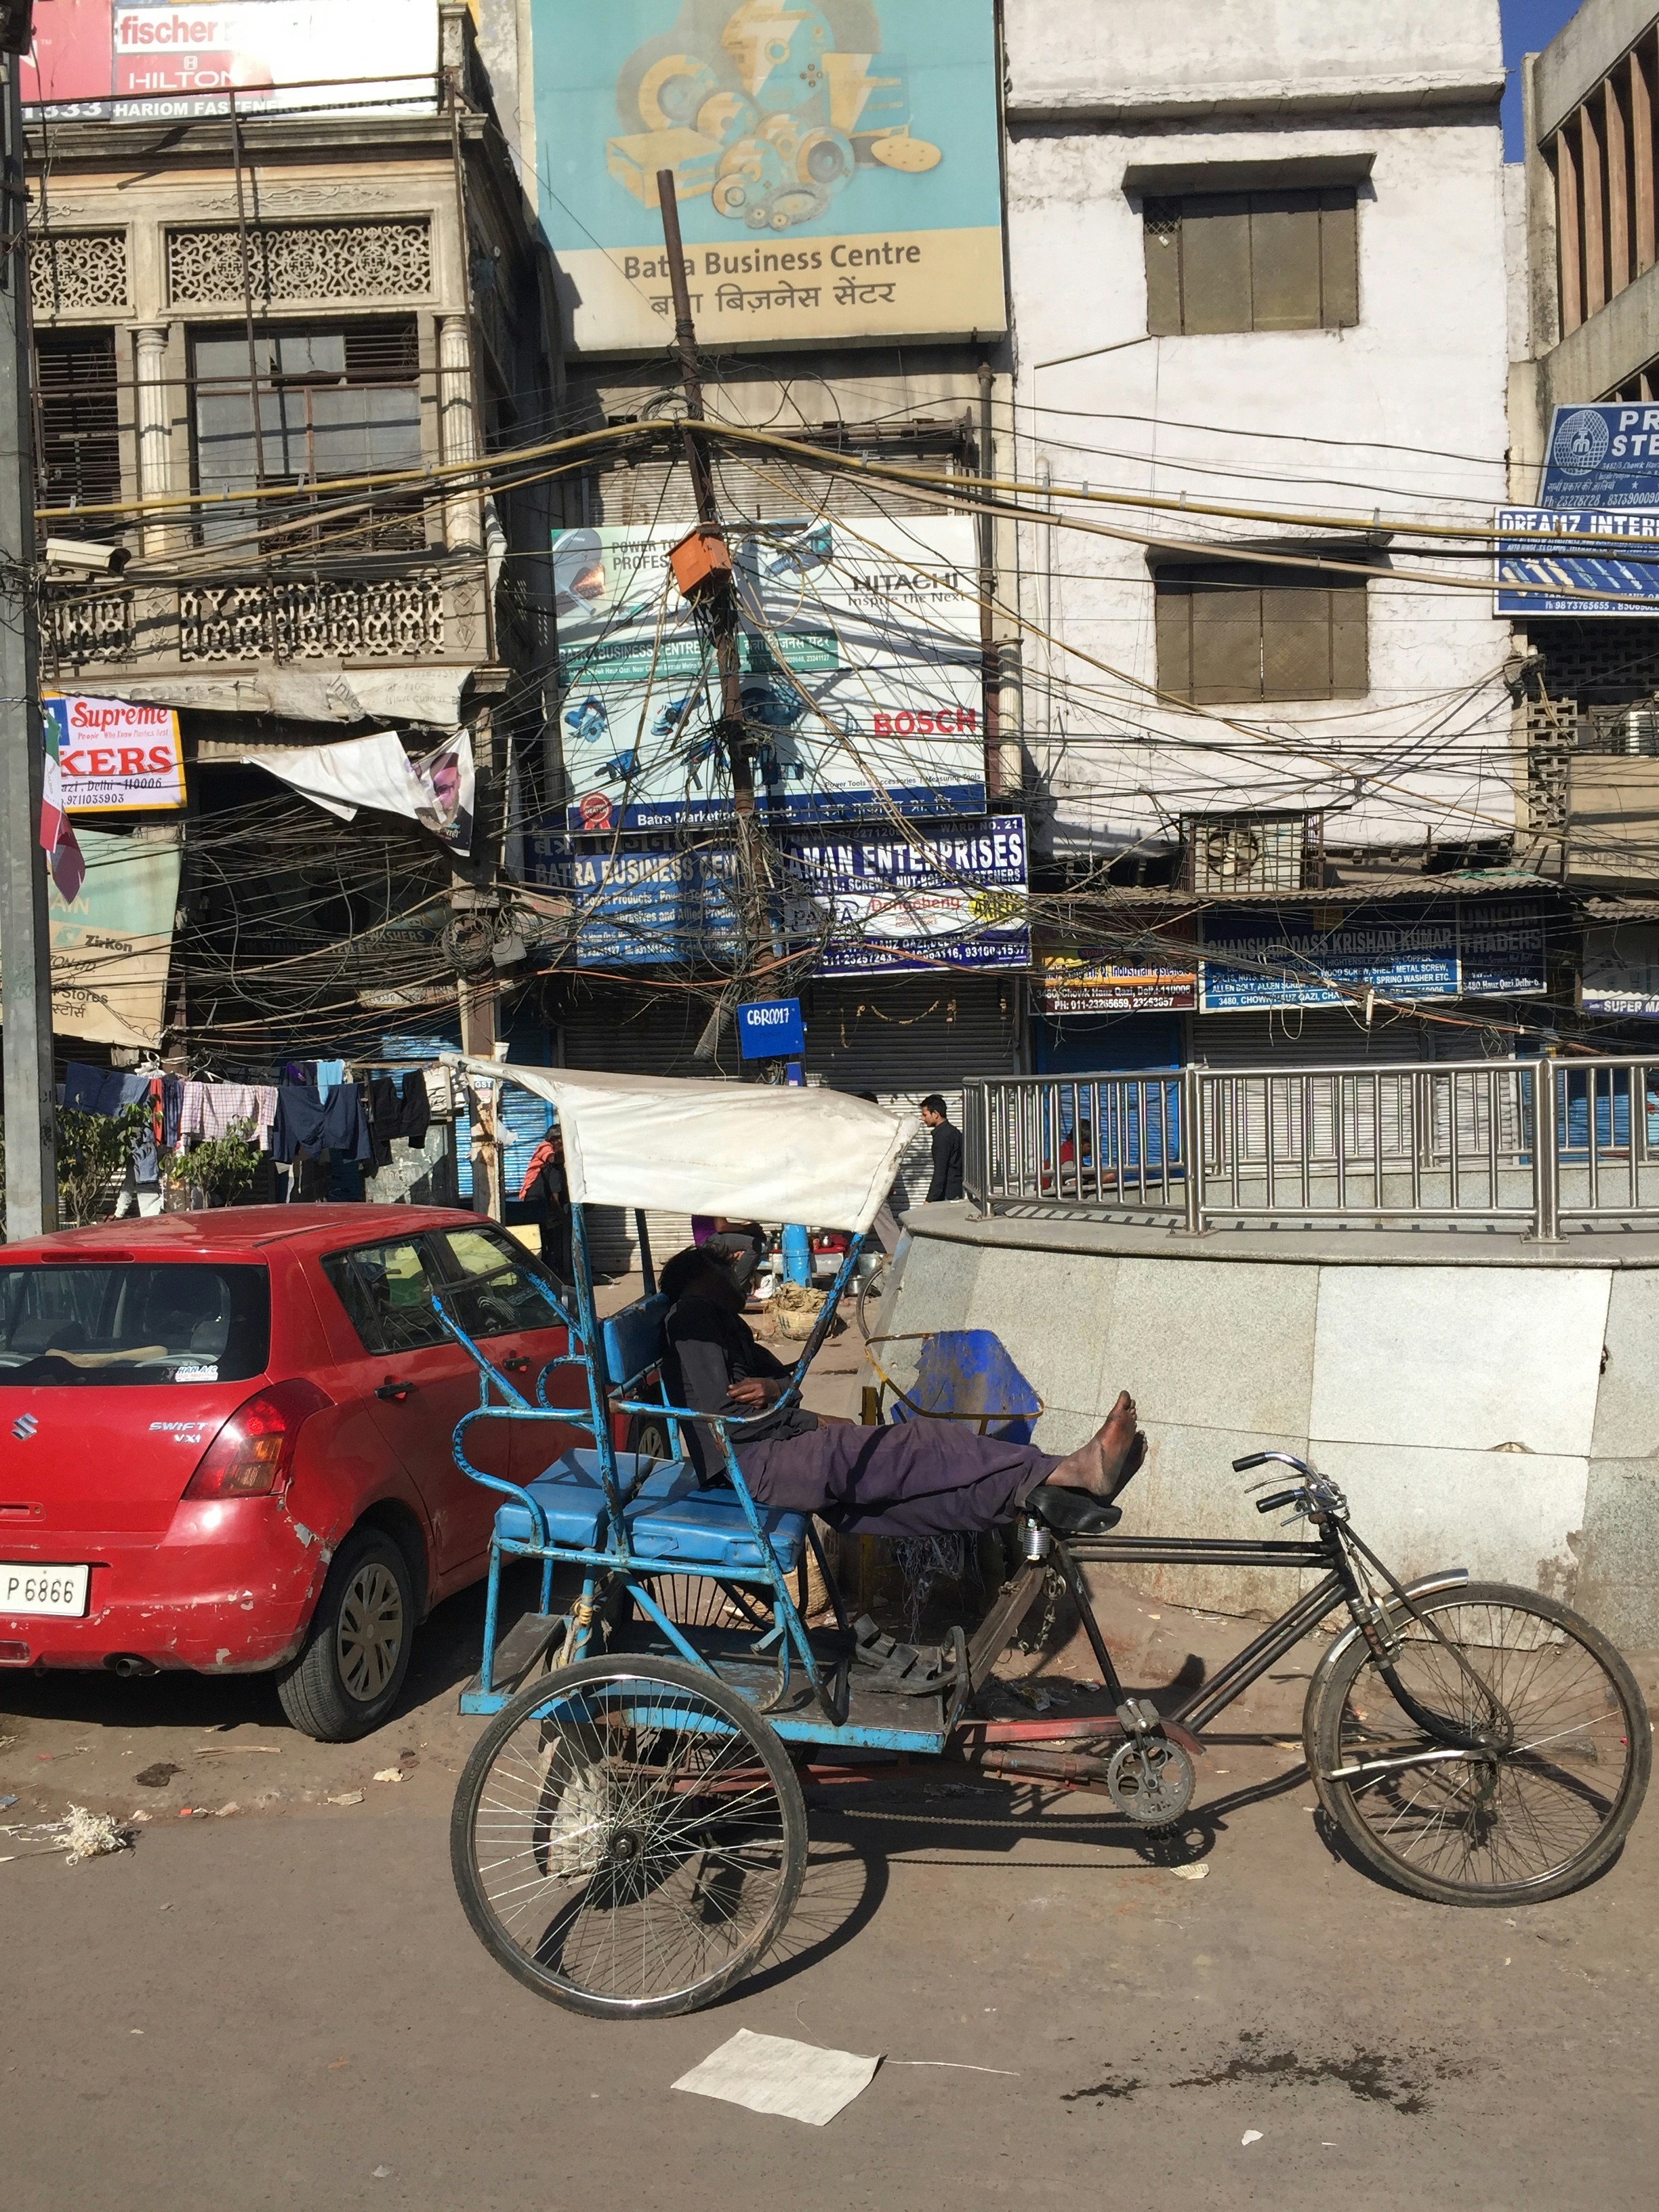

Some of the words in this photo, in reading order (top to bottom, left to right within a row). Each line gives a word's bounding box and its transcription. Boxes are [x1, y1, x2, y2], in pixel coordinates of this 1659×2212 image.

[120, 15, 218, 44] fischer
[115, 103, 188, 117] HARIOM
[624, 255, 696, 279] Bata
[705, 249, 822, 275] Business
[830, 241, 921, 267] Centre
[612, 541, 657, 554] POWER
[853, 573, 958, 592] HITACHI
[848, 594, 898, 607] Inspire
[903, 594, 926, 604] the
[932, 589, 966, 602] Next
[598, 644, 654, 660] BUSINESS
[655, 642, 701, 657] ENTRE
[70, 701, 168, 731] Supreme
[874, 708, 977, 737] BOSCH
[848, 779, 866, 787] Tools
[963, 773, 981, 781] Tools
[638, 812, 672, 826] Batra
[941, 822, 976, 834] WARD
[979, 821, 1001, 830] NO.
[1004, 819, 1019, 830] 21
[789, 846, 854, 880] AMAN
[863, 833, 1023, 876] ENTERPRISES
[535, 861, 596, 886] BATRA
[601, 855, 694, 885] BUSINESS
[1461, 905, 1538, 929] UNICOM
[85, 934, 133, 952] ZirKon
[1291, 935, 1328, 954] DASS
[1333, 931, 1395, 954] KRISHAN
[1400, 928, 1453, 951] KUMAR
[1464, 929, 1542, 954] TRADERS
[1111, 964, 1152, 977] Industrial
[1344, 967, 1371, 977] SCREW,
[1372, 965, 1395, 975] SHEET
[1396, 964, 1420, 974] METAL
[1421, 963, 1449, 972] SCREW,
[1212, 984, 1235, 993] ALLEN
[1236, 983, 1256, 992] BOLT,
[1258, 982, 1281, 991] ALLEN
[1376, 975, 1403, 985] SPRING
[1404, 973, 1435, 983] WASHER
[1435, 972, 1452, 982] ETC.
[1061, 989, 1090, 998] Chowk
[1092, 987, 1113, 997] Hauz
[1114, 987, 1135, 997] Qazi,
[1218, 996, 1240, 1006] 3480,
[1054, 998, 1069, 1010] PH:
[1603, 1000, 1643, 1012] SUPER
[747, 1008, 790, 1025] CBR0017
[474, 1080, 492, 1088] GST
[148, 1422, 209, 1431] SWIFT
[7, 1577, 20, 1600] P
[25, 1578, 74, 1603] 6866
